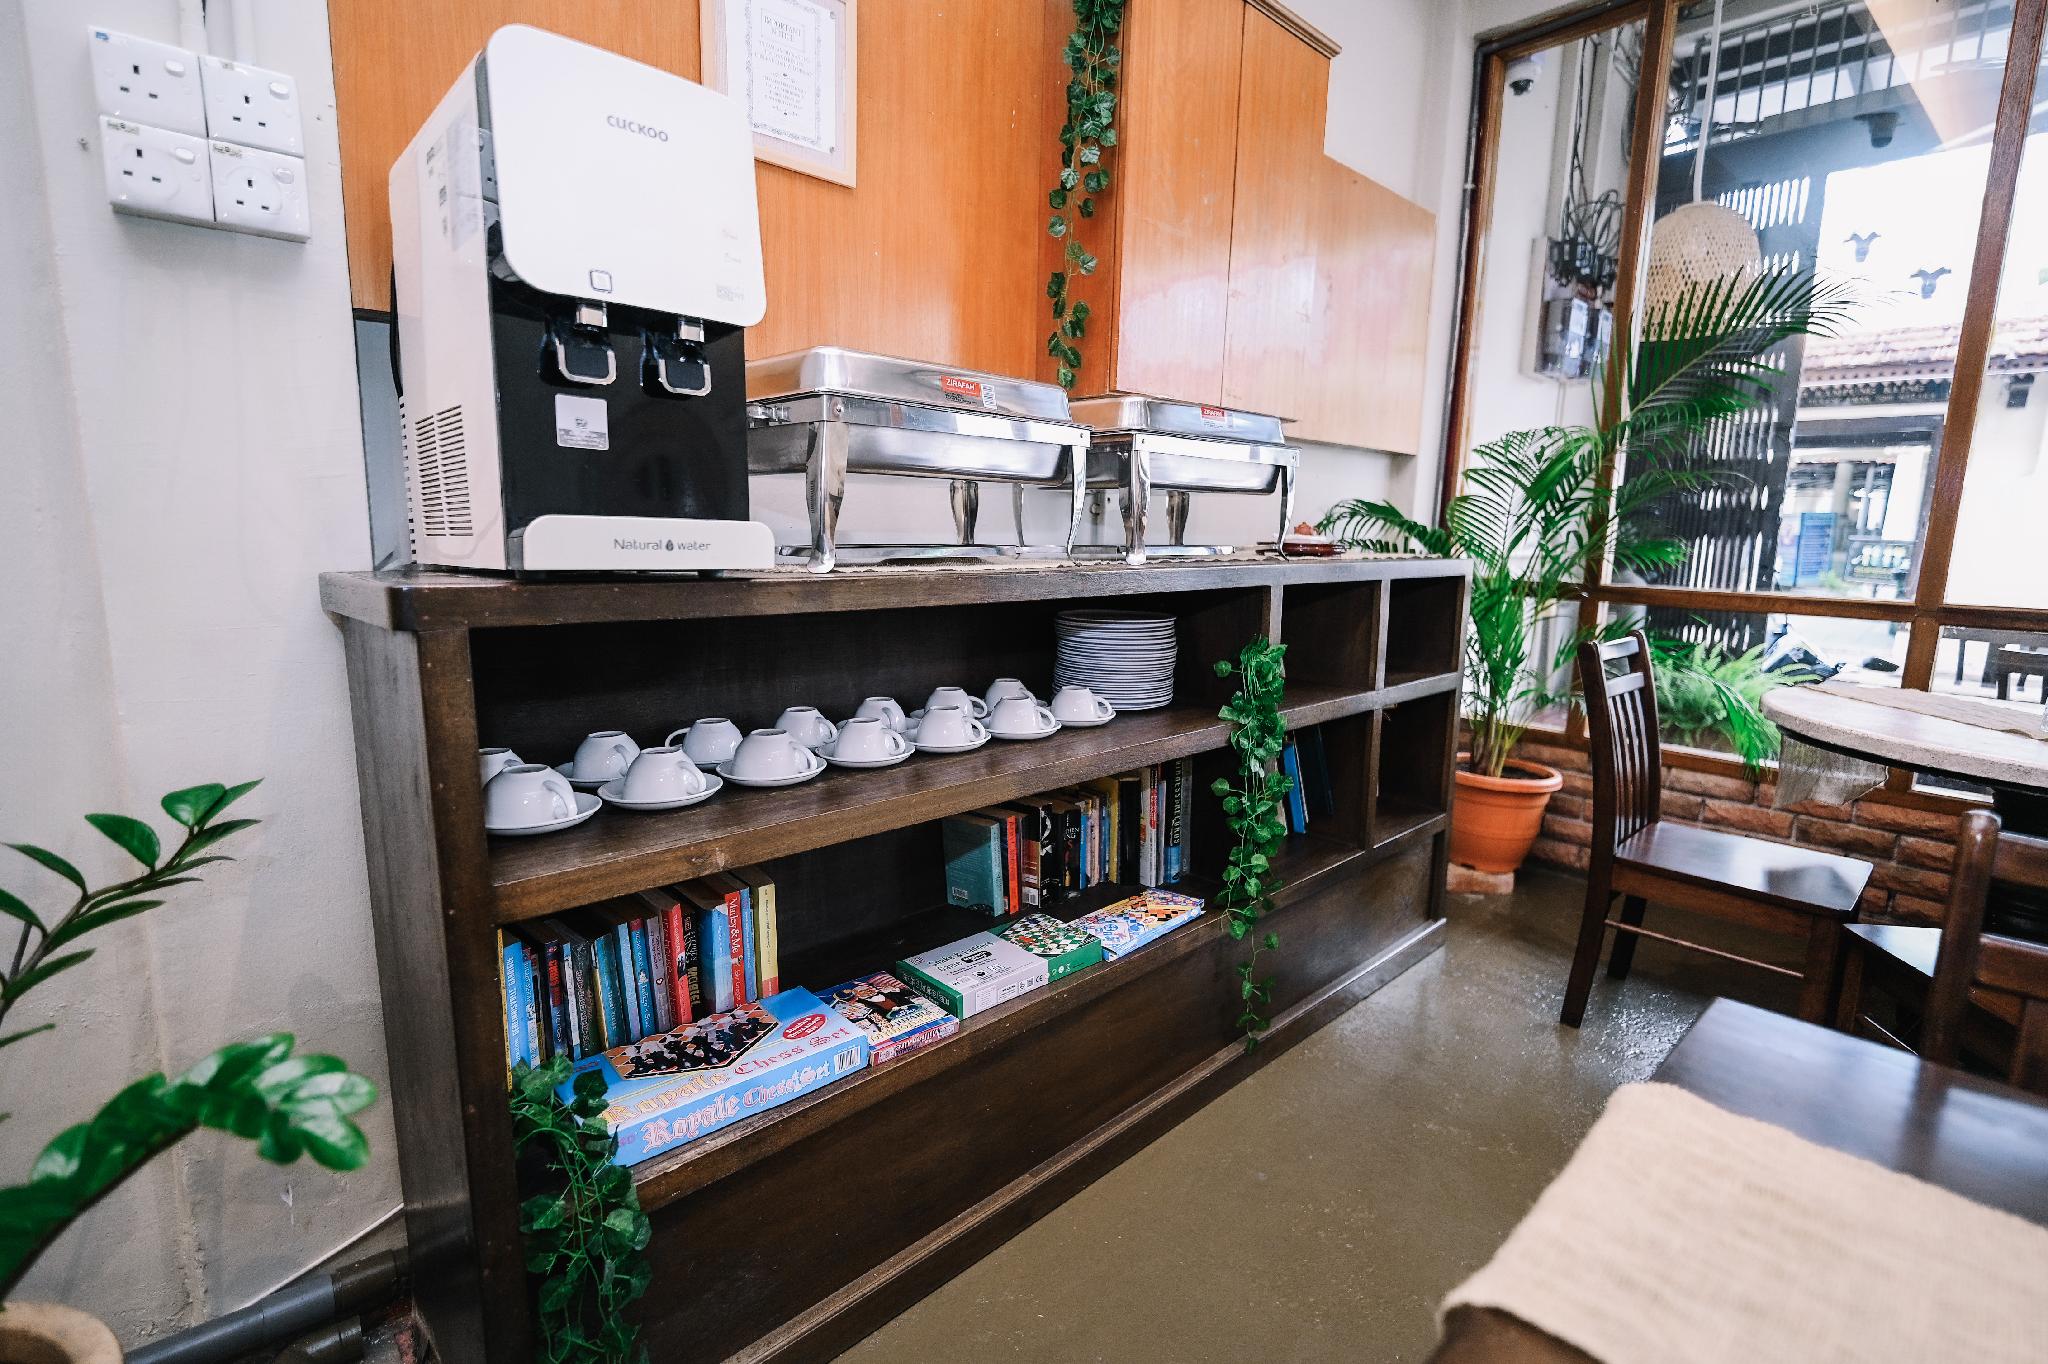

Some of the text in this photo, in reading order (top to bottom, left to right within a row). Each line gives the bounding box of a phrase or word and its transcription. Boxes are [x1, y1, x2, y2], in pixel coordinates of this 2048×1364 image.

[606, 115, 669, 142] CUCKOO
[945, 378, 976, 391] ZIRAFAH
[613, 538, 711, 551] Natural water
[602, 1026, 850, 1124] Royale Chess Set
[641, 1091, 740, 1153] Royale
[742, 1068, 795, 1108] Chess
